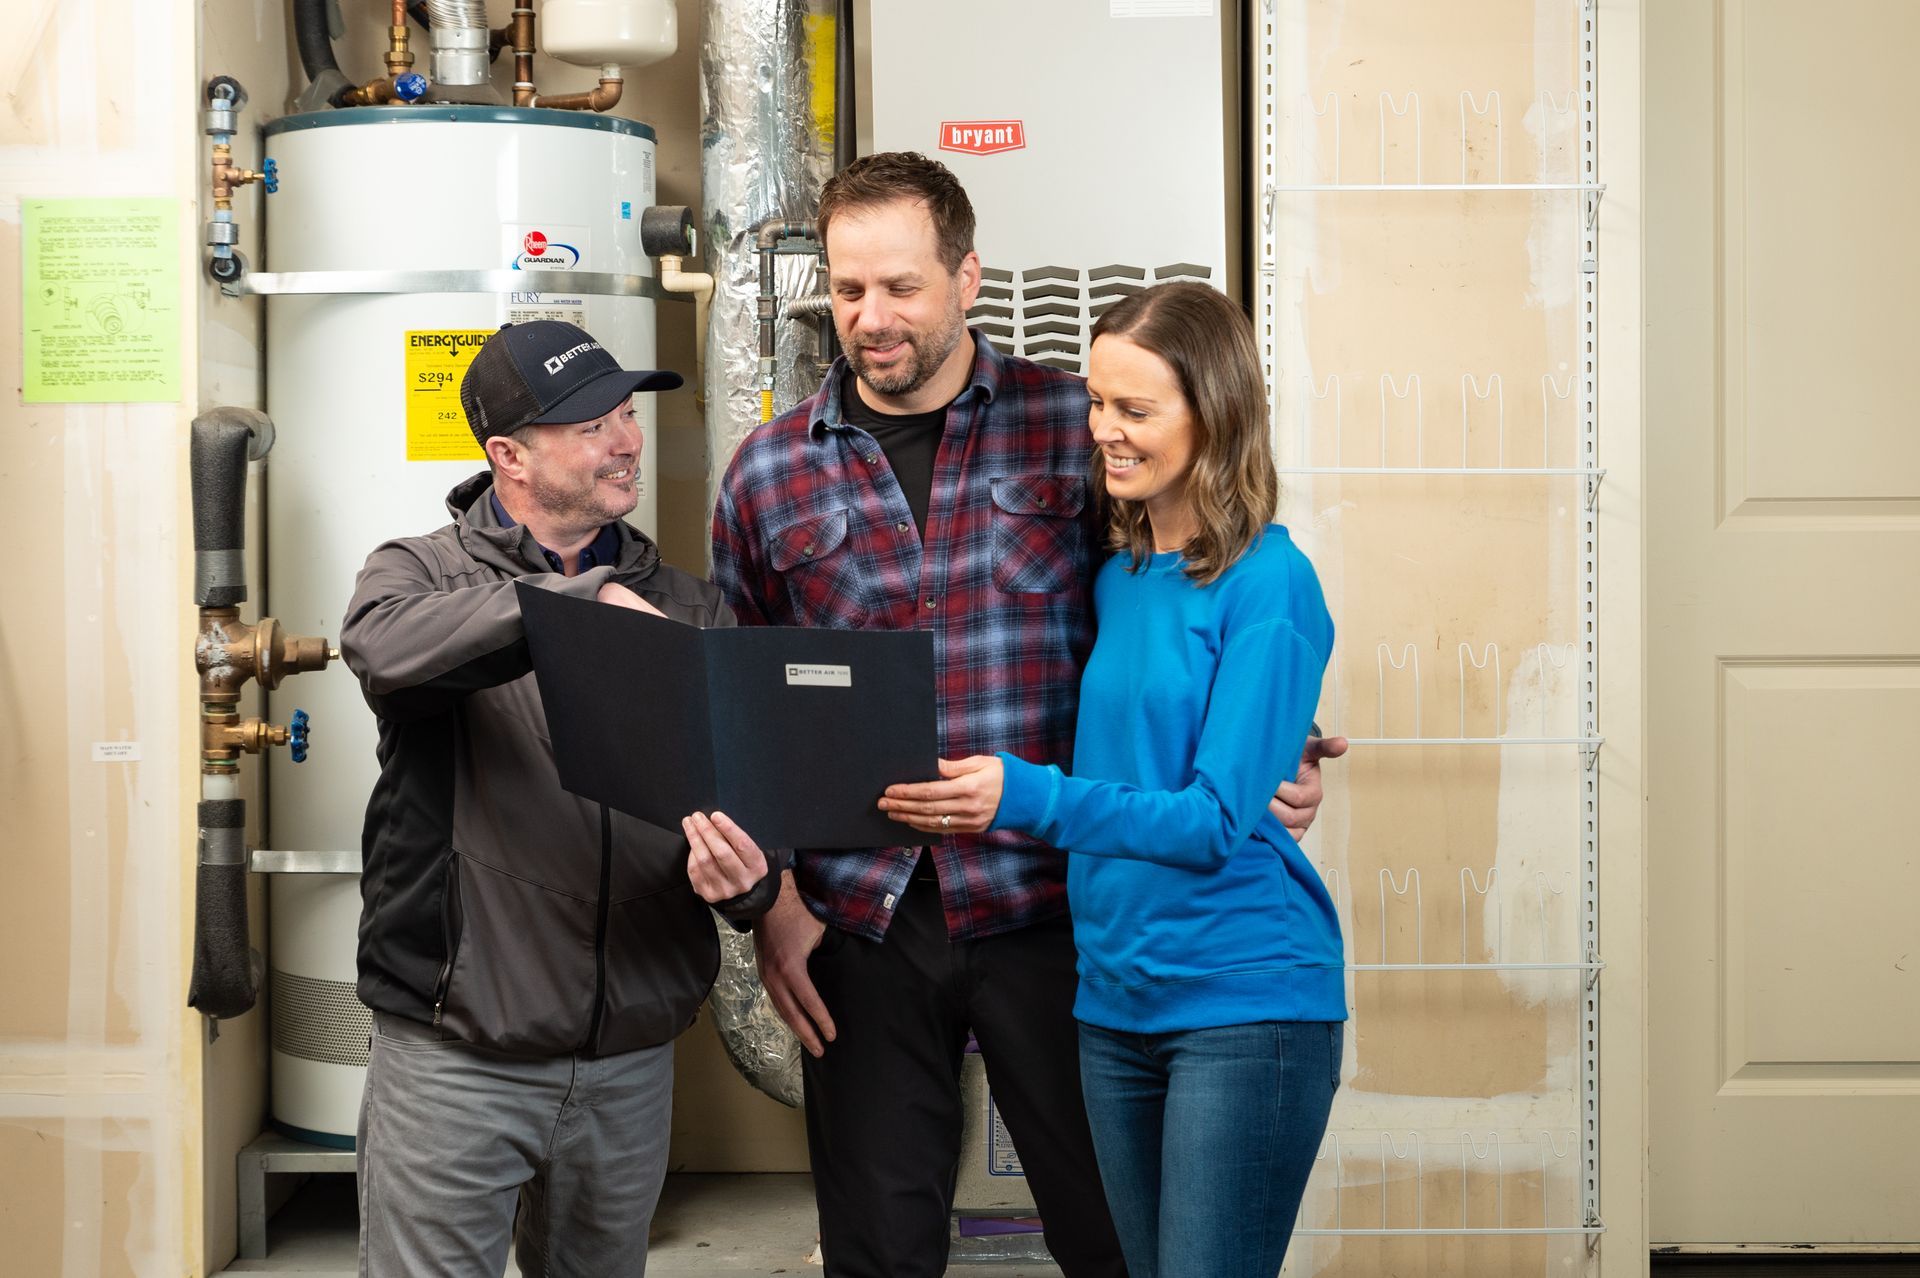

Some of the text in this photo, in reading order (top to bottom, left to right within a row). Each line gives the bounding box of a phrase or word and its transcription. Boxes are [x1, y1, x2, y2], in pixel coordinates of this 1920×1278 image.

[952, 126, 1014, 147] bryant
[525, 231, 547, 252] Rheem
[511, 292, 541, 303] FURY
[559, 343, 592, 363] BETTER
[437, 412, 457, 420] 242
